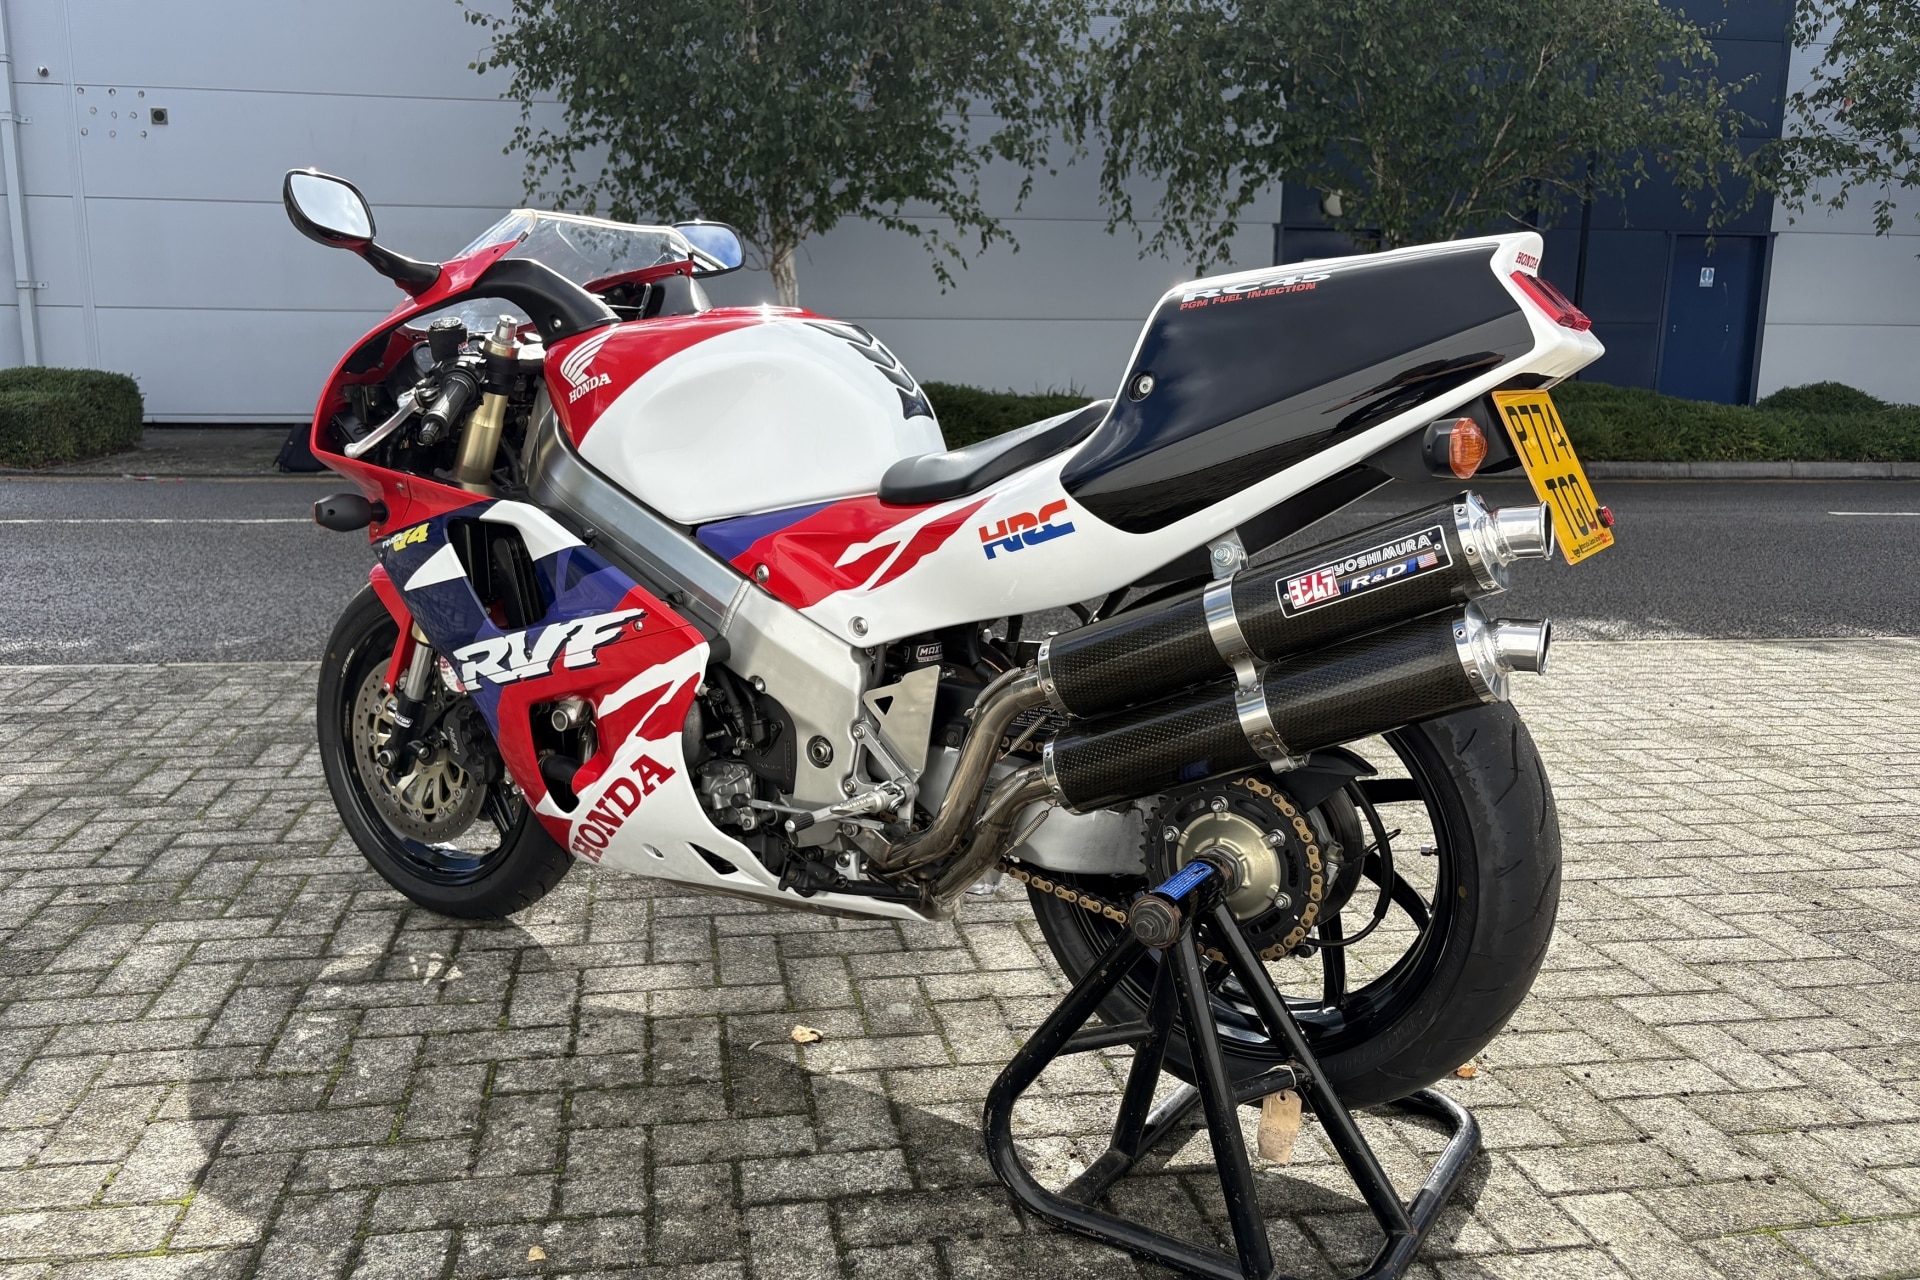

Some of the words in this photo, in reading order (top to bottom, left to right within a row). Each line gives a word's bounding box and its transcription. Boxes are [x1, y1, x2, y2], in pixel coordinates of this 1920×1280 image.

[1515, 251, 1539, 270] HONDA
[1180, 300, 1209, 311] PGM
[1212, 293, 1243, 305] FUEL
[1247, 282, 1317, 299] INJECTION
[1181, 271, 1331, 303] RC45
[568, 373, 612, 405] HONDA
[1504, 403, 1572, 468] P774
[393, 523, 430, 552] V4
[978, 498, 1076, 561] HRC
[1333, 534, 1432, 576] YOSHIMURA
[1350, 563, 1408, 591] R&D
[452, 607, 648, 692] RVF
[571, 753, 677, 864] HONDA
